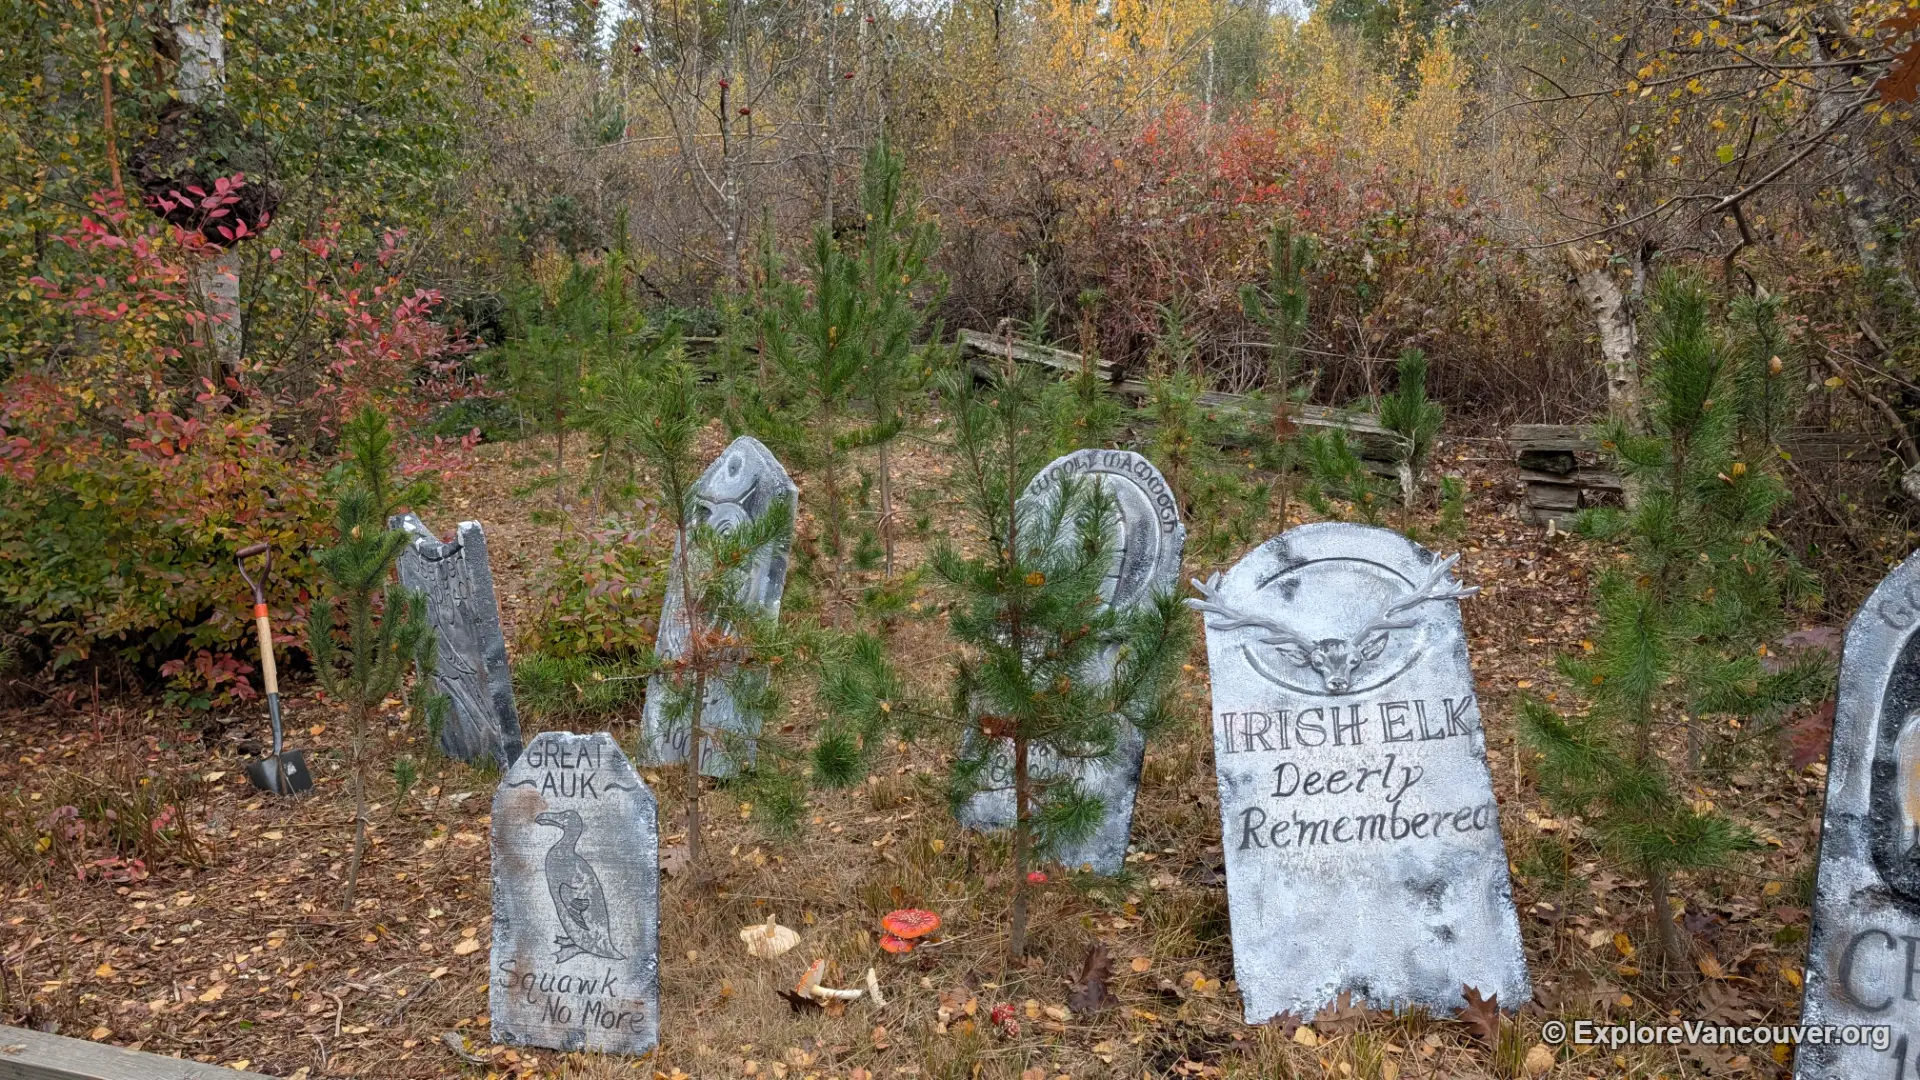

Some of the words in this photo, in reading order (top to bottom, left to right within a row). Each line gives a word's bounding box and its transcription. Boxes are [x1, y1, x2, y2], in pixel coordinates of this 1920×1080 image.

[1104, 452, 1178, 534] MAMMOTH
[1220, 703, 1368, 754] IRISH
[1377, 695, 1474, 743] ELK
[527, 740, 606, 769] GREAT
[1271, 753, 1424, 803] Deerly
[541, 771, 598, 799] AUK
[1238, 800, 1492, 851] Remembered
[499, 959, 618, 1004] Squawk
[542, 995, 572, 1025] No
[581, 999, 645, 1034] More
